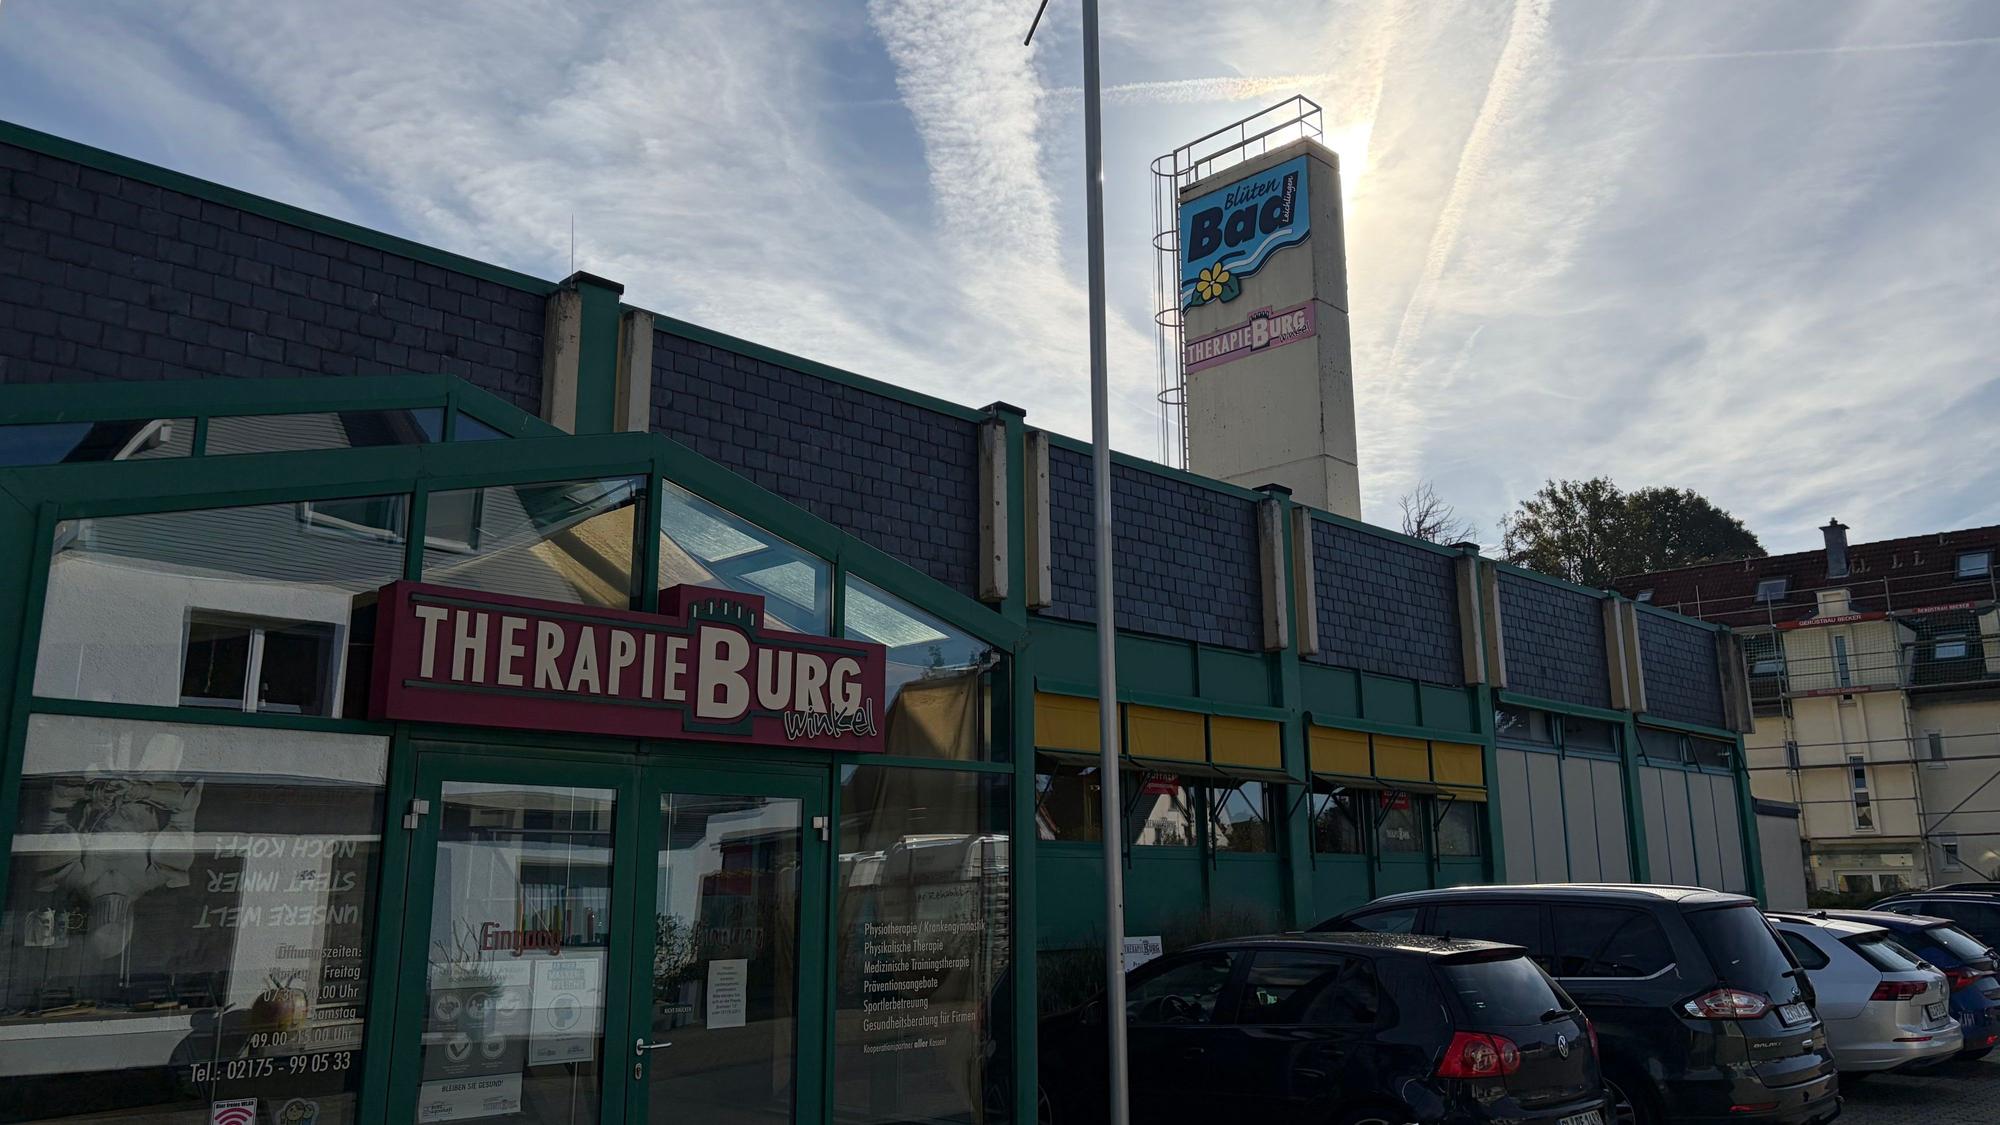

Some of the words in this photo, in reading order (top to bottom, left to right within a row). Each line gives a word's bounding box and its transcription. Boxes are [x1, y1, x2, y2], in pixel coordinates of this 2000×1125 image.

[1224, 178, 1280, 210] Blüten
[1188, 171, 1298, 263] Bad
[292, 838, 358, 858] NOCH
[192, 904, 261, 929] WELT
[268, 903, 360, 927] UNSERE
[864, 921, 917, 938] Physiotherapie
[864, 940, 911, 956] Physikalische
[912, 938, 944, 954] Therapie
[324, 964, 362, 980] Freitag
[863, 959, 909, 974] Medizinische
[911, 955, 970, 972] Trainingstherapie
[338, 983, 359, 999] Uhr
[863, 997, 929, 1015] Sportlerbetreuung
[863, 1014, 939, 1032] Gesundheitsberatung
[940, 1010, 951, 1025] für
[952, 1009, 976, 1023] Firmen
[252, 1032, 287, 1048] 09.00
[334, 1026, 353, 1041] Uhr
[190, 1062, 221, 1083] Tel.:
[227, 1058, 274, 1080] 02175
[288, 1055, 308, 1075] 99
[311, 1053, 330, 1073] 05
[332, 1051, 352, 1071] 33
